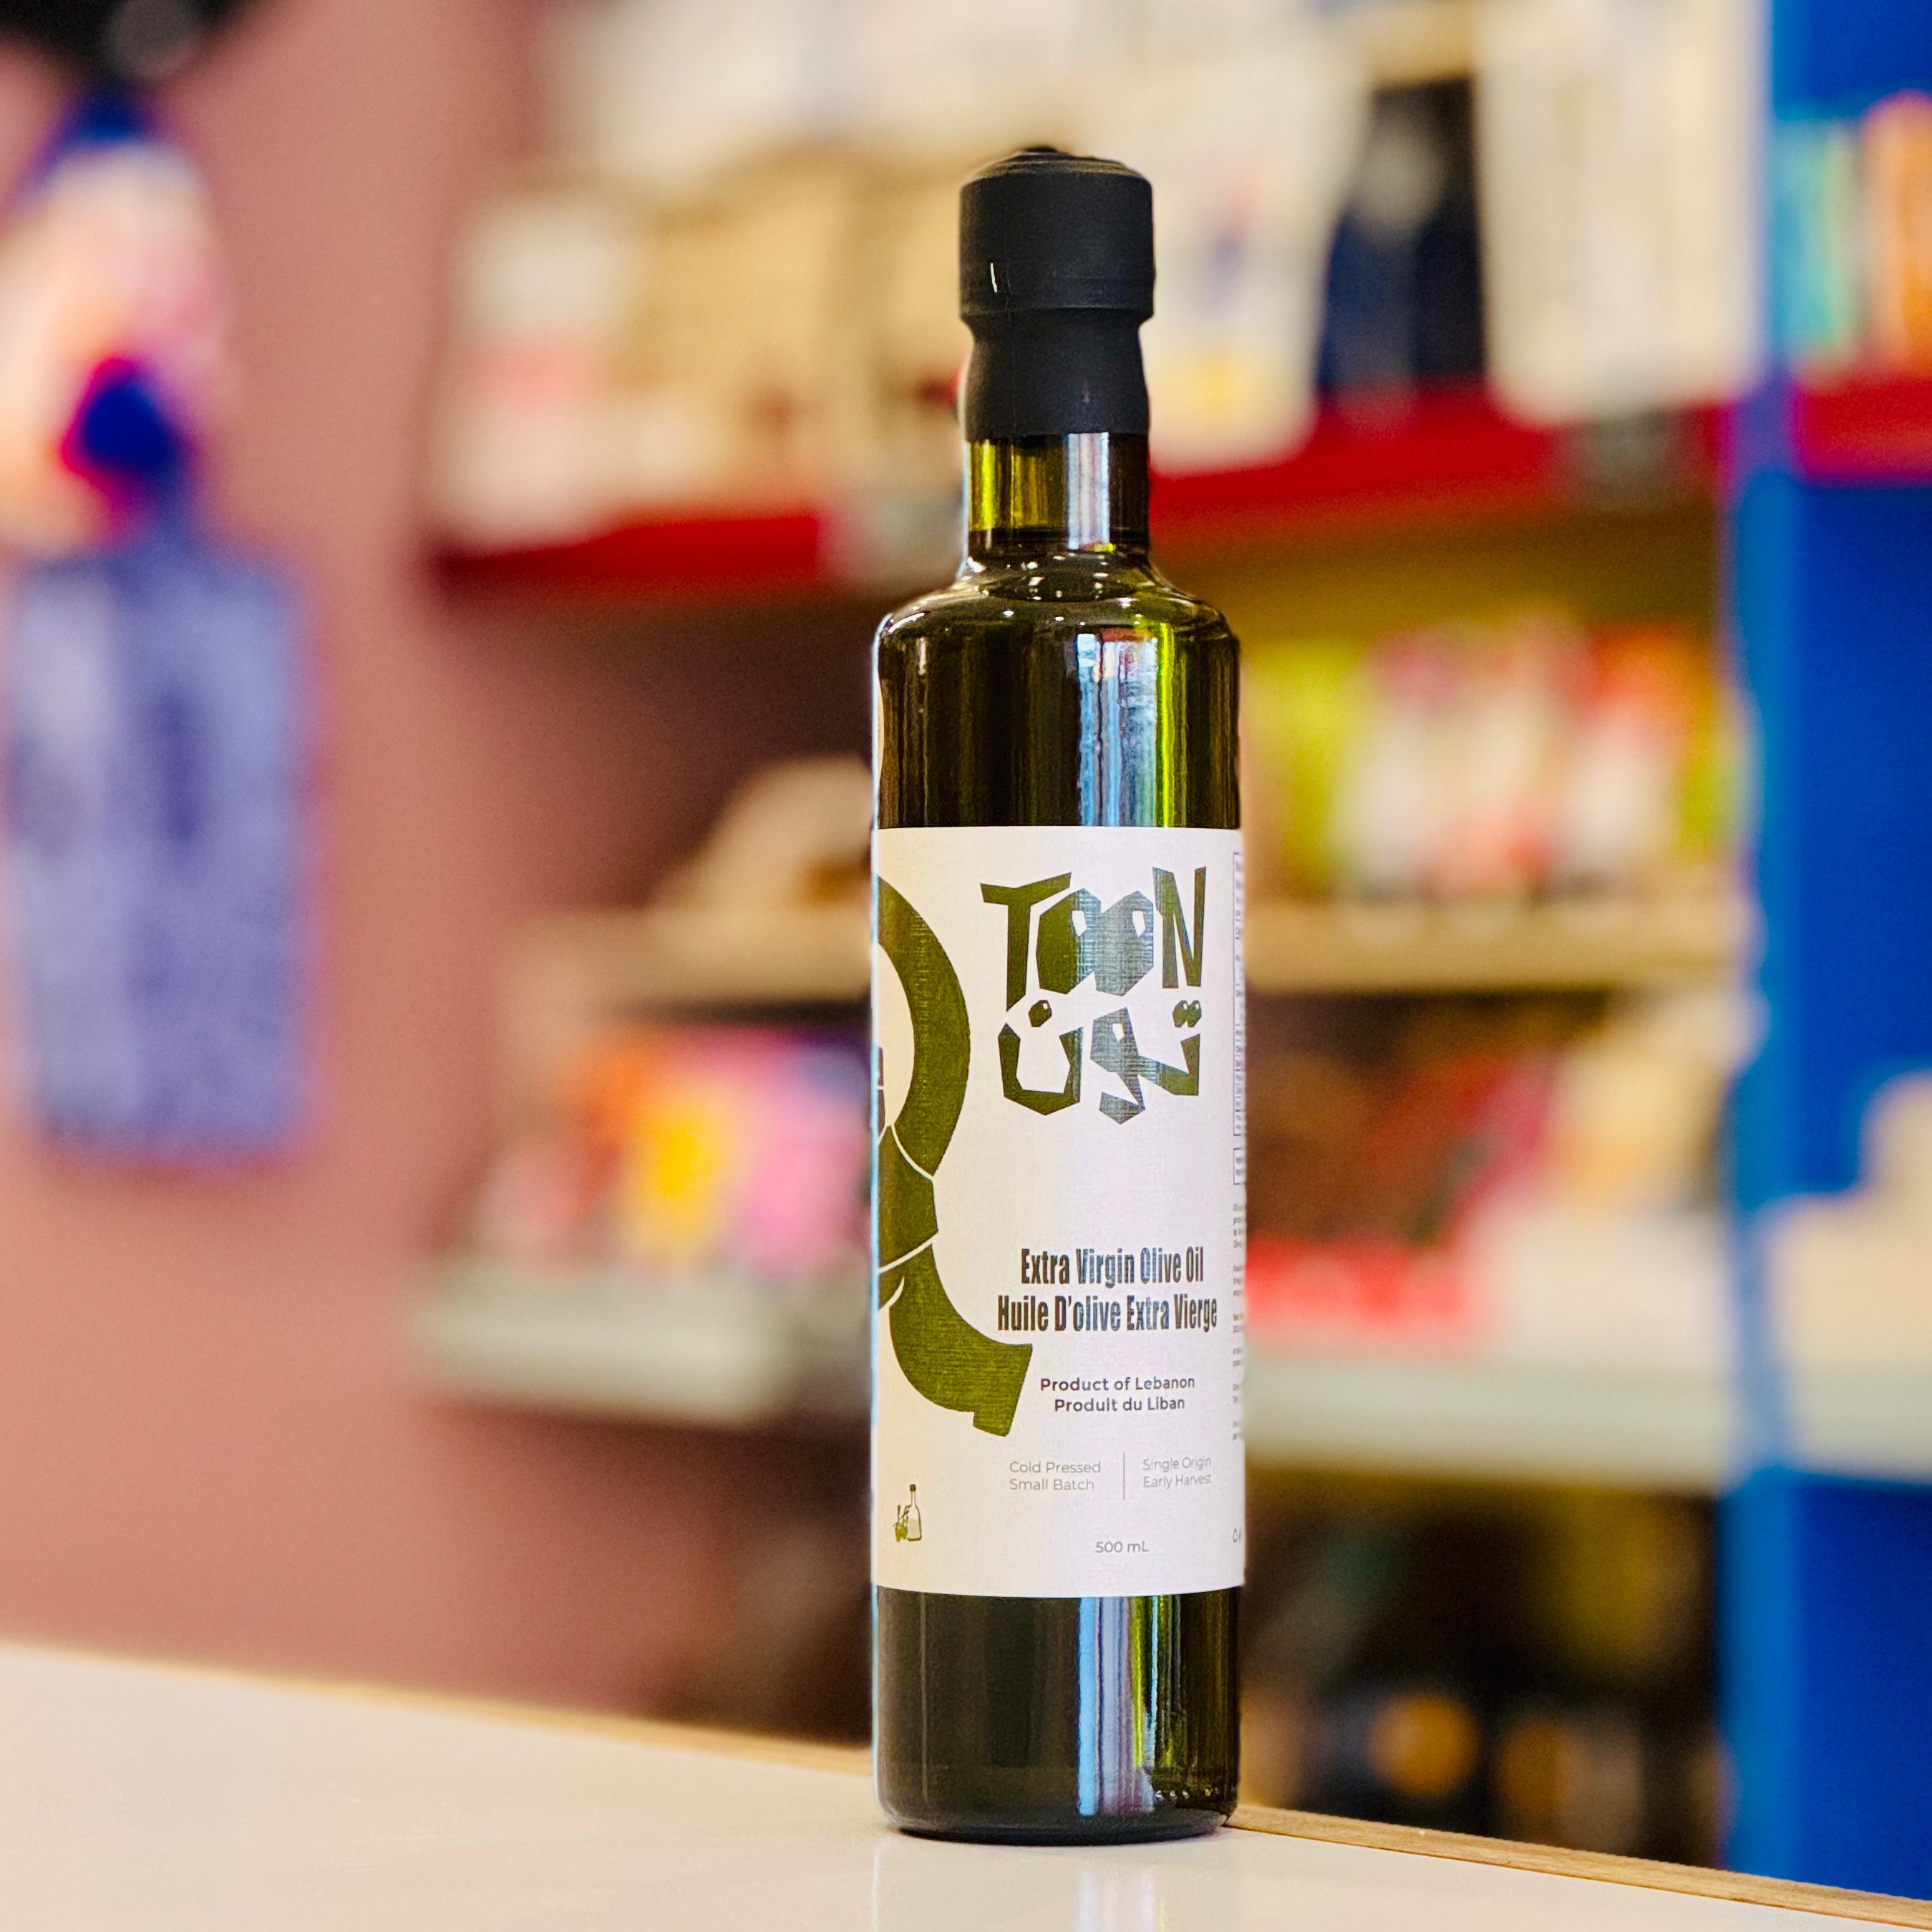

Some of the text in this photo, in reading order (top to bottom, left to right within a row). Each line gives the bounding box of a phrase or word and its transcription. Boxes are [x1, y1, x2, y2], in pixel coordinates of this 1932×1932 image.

[979, 865, 1207, 1012] TOON
[1021, 1247, 1070, 1286] Extra
[1075, 1247, 1135, 1290] Virgin
[1140, 1246, 1182, 1285] Olive
[1185, 1246, 1205, 1283] Oil
[997, 1294, 1049, 1332] Huile
[1054, 1294, 1121, 1333] D'olive
[1126, 1294, 1170, 1331] Extra
[1173, 1293, 1218, 1334] Vierge
[1040, 1376, 1195, 1392] Product of Lebanon
[1054, 1396, 1185, 1413] Produit du Liban
[1009, 1460, 1102, 1474] Cold Pressed
[1142, 1455, 1212, 1474] Single Origin
[1009, 1477, 1094, 1491] Small Batch
[1142, 1472, 1212, 1490] Early Harvest
[1095, 1540, 1150, 1554] 500 mL
